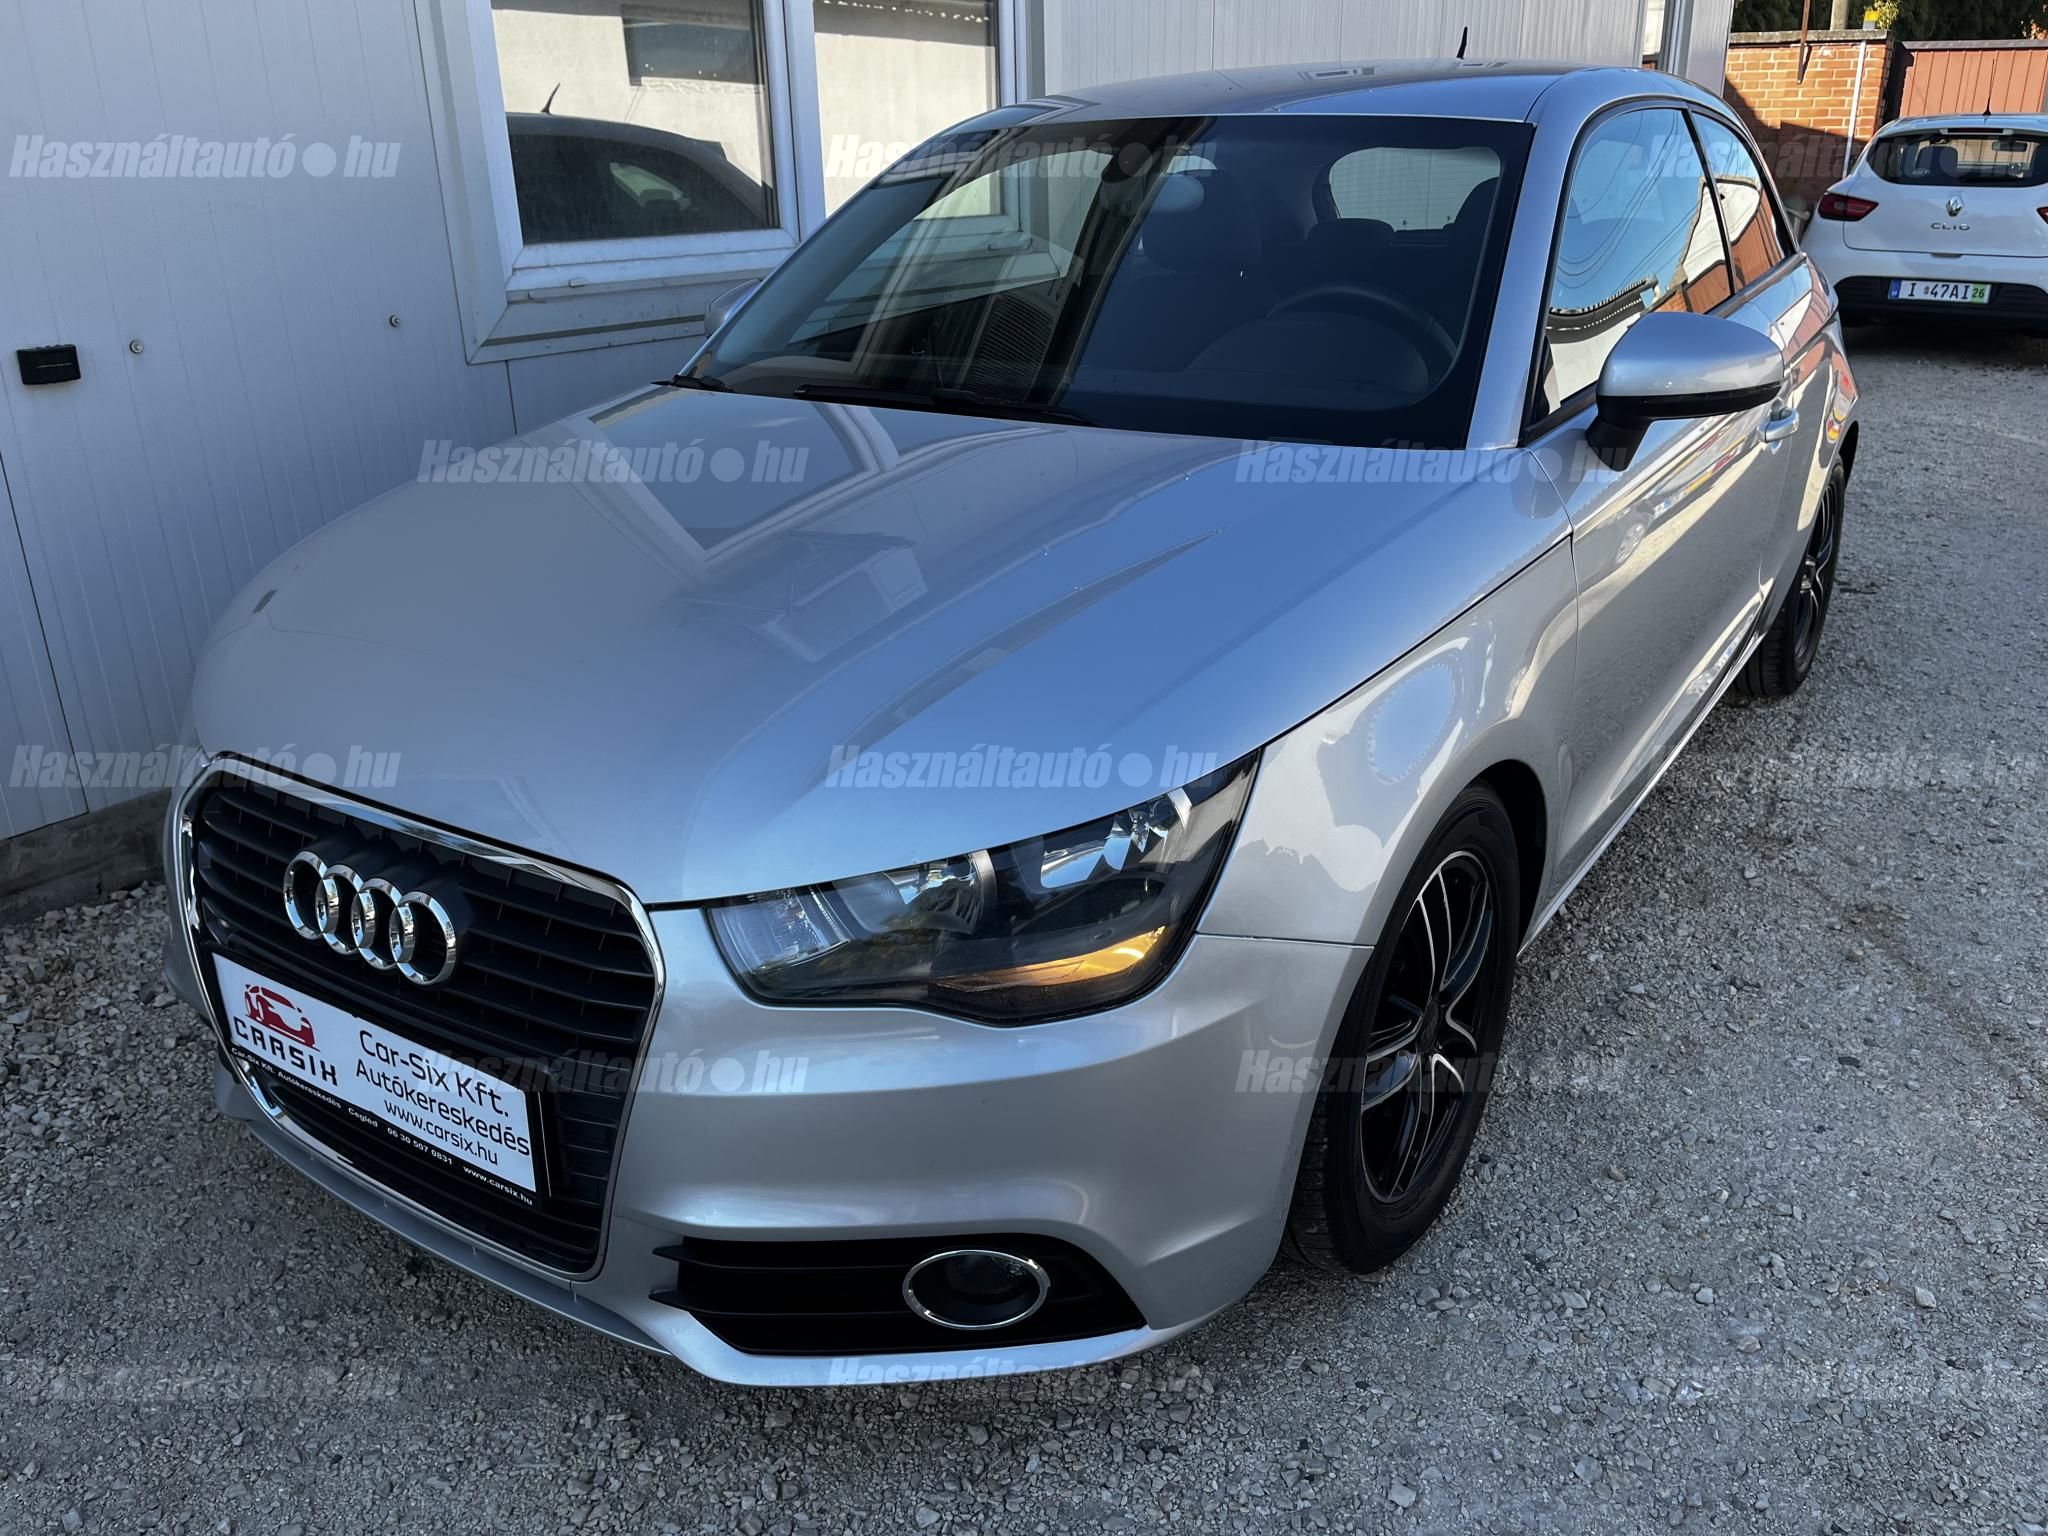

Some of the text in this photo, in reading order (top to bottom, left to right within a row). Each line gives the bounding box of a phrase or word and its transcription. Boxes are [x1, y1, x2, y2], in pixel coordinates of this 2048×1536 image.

[1931, 222, 1971, 231] CLIO
[1972, 287, 1985, 298] 26
[355, 1058, 531, 1157] Autókereskedés
[359, 1029, 509, 1118] Car-Six Kft.
[277, 1071, 343, 1109] Autókereskedés
[348, 1107, 379, 1128] Cegléd
[400, 1134, 411, 1144] 30
[463, 1165, 533, 1206] www.carsix.hu
[384, 1099, 498, 1166] www.carsix.hu
